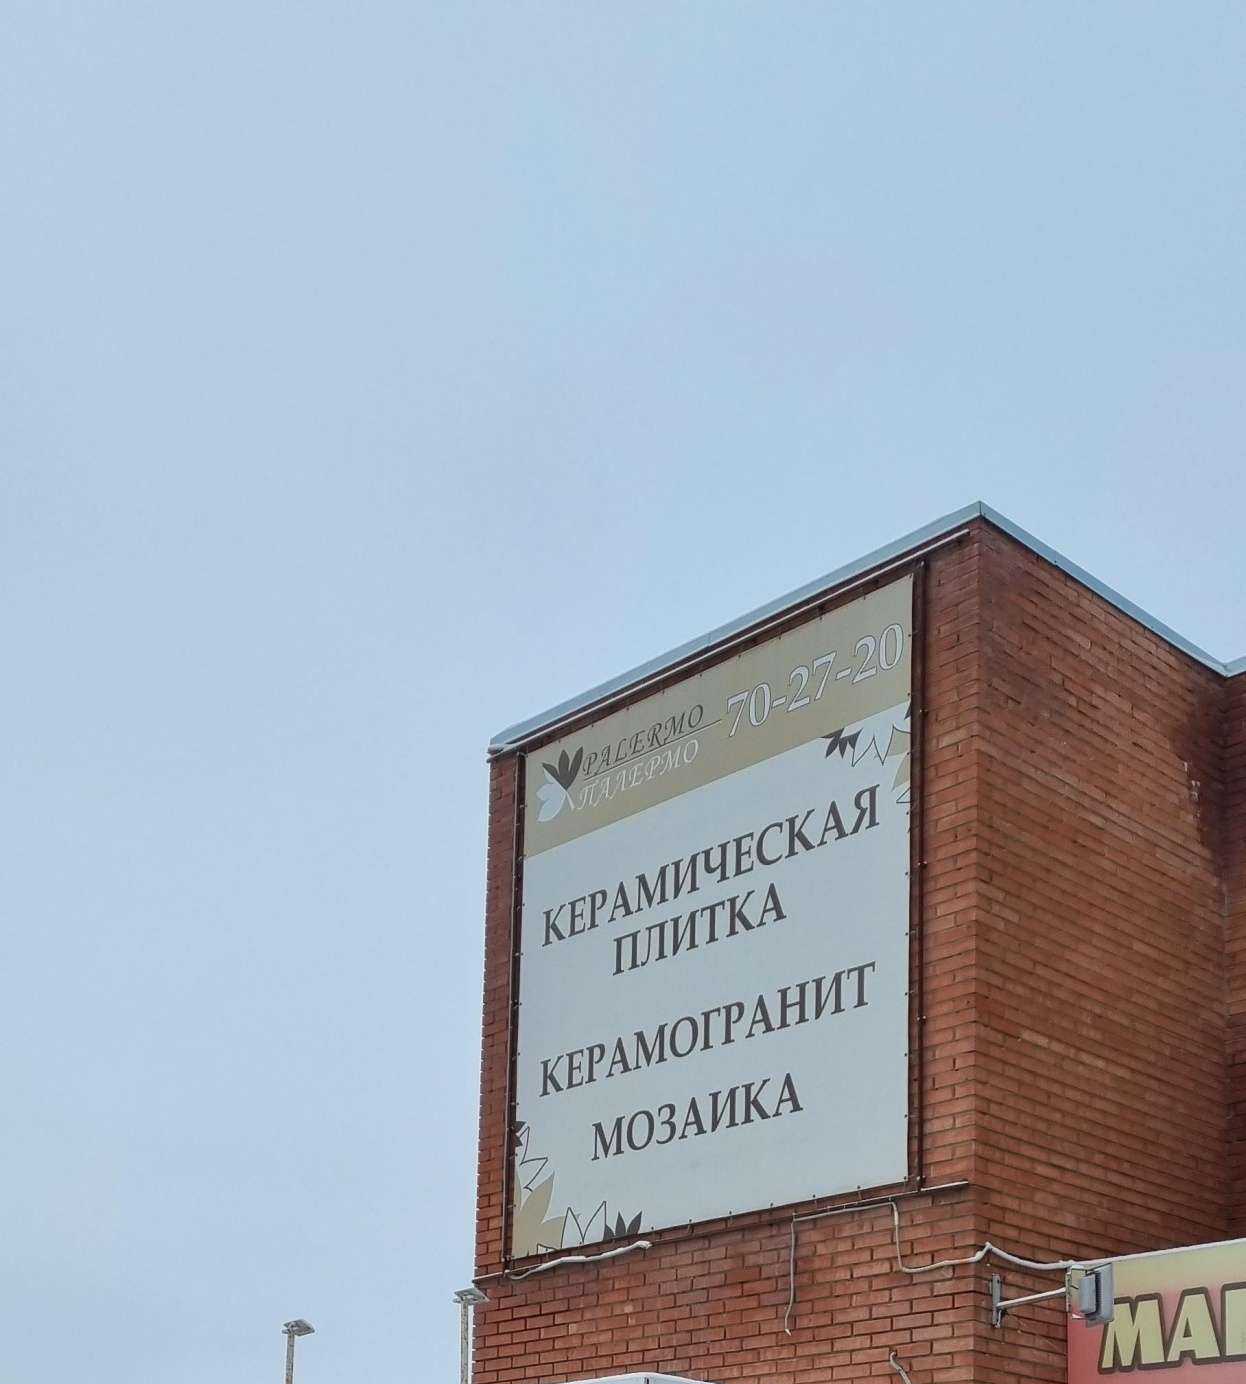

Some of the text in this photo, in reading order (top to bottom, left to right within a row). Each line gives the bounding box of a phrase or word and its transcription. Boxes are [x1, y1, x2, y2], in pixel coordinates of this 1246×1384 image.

[726, 622, 904, 737] 70-27-20
[575, 739, 699, 810] ПАЛЕРМО
[582, 704, 704, 777] PALERMO
[541, 784, 880, 947] КЕРАМИЧЕСКАЯ
[613, 882, 787, 976] ПЛИТКА
[539, 961, 876, 1097] КЕРАМОГРАНИТ
[591, 1072, 804, 1161] МОЗАИКА
